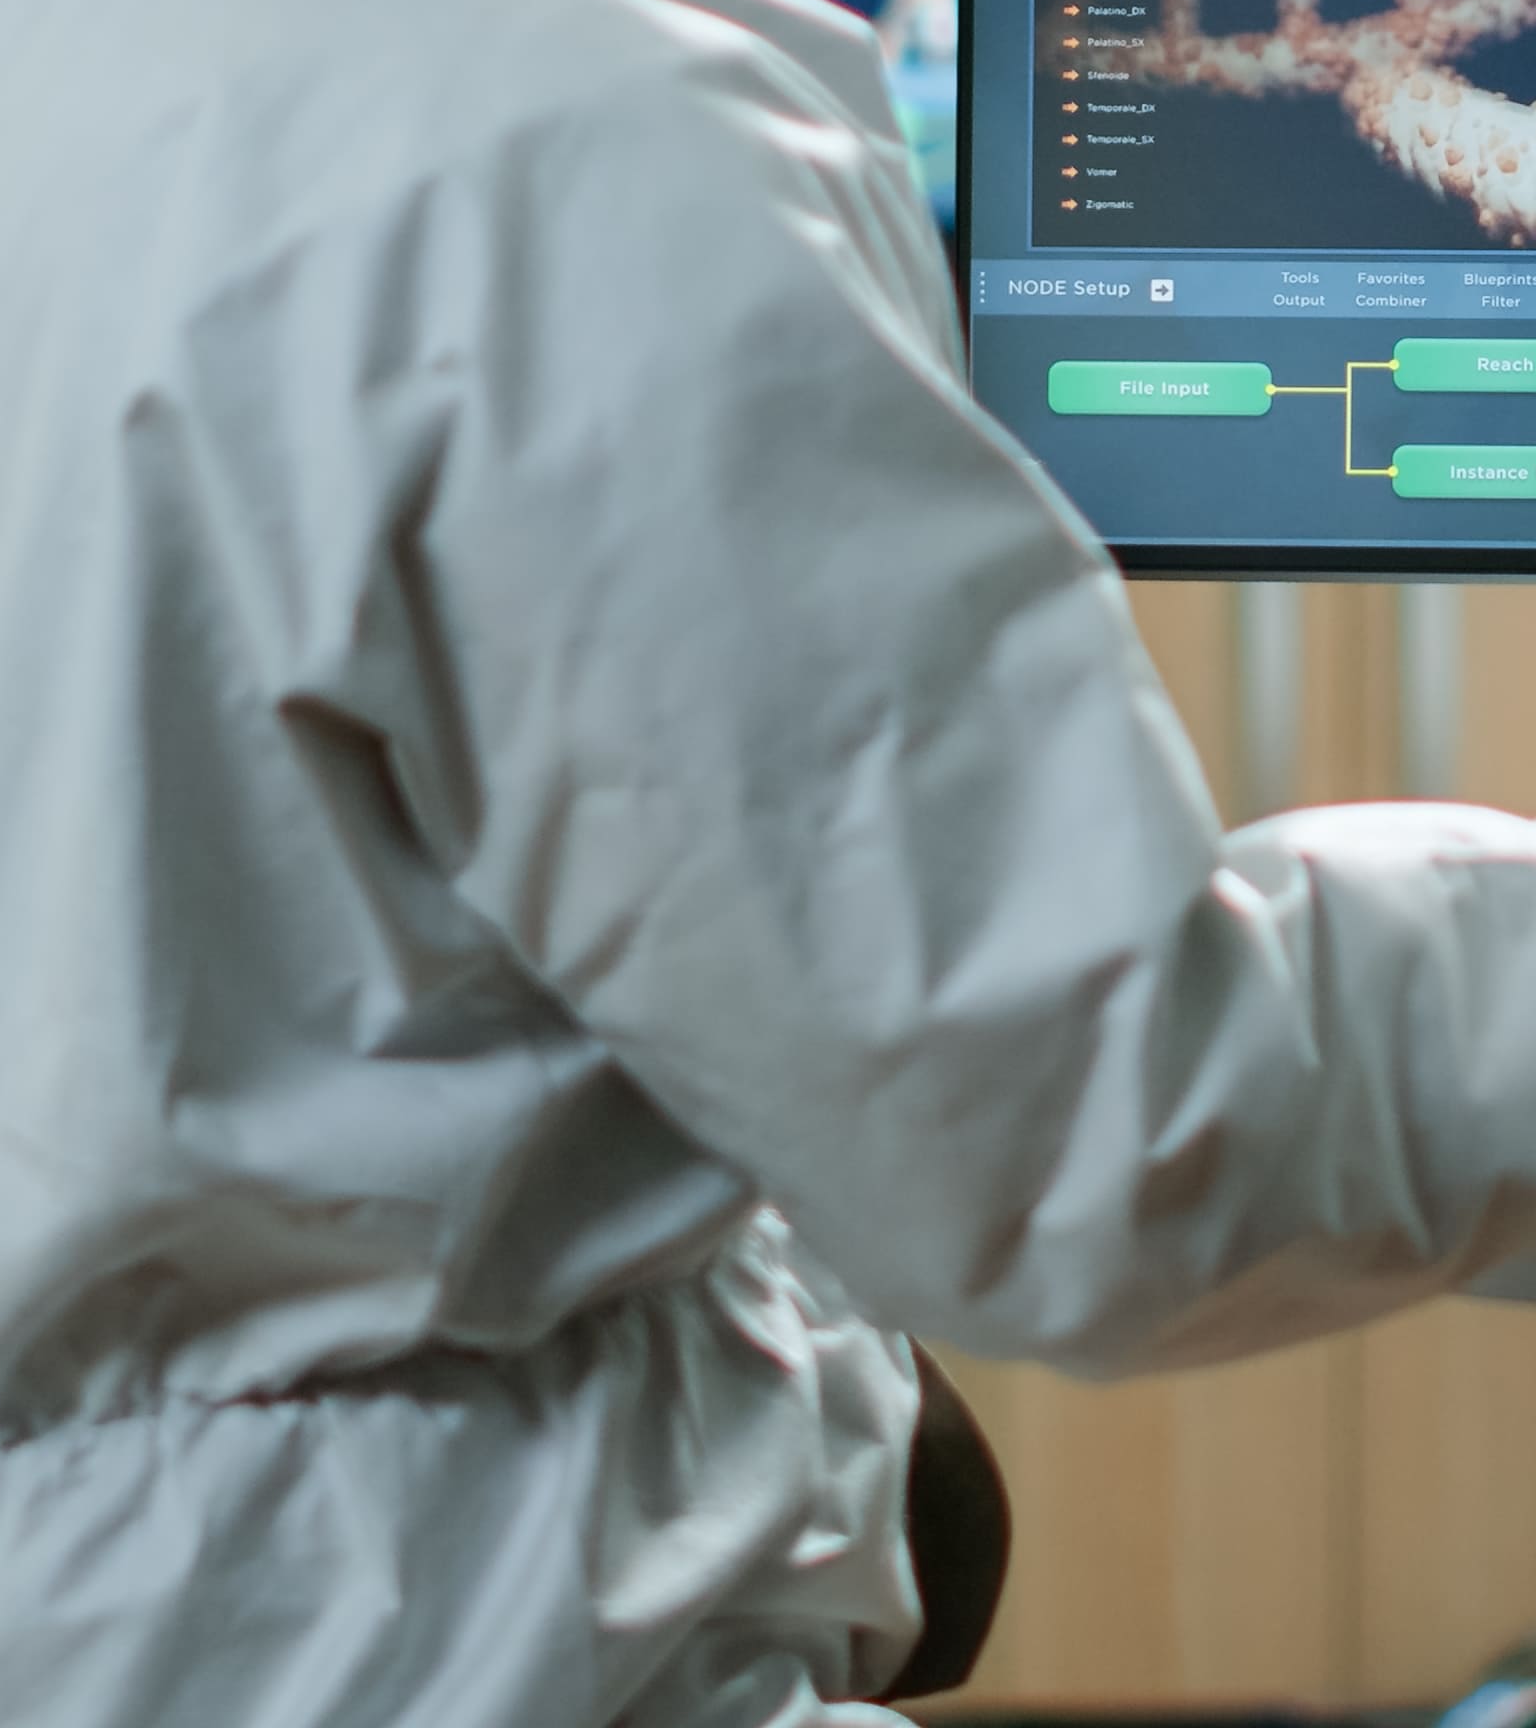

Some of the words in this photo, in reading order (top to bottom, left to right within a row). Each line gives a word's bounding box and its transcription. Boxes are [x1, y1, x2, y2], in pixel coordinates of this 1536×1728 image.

[1087, 6, 1146, 17] Palatino_DX
[1087, 37, 1145, 49] Palatino_SX
[1087, 71, 1130, 81] Sfenoide
[1087, 102, 1156, 114] Temporale_DX
[1086, 134, 1155, 145] Temporale_SX
[1086, 167, 1118, 177] Vomer
[1085, 199, 1134, 211] Zigomatic
[1281, 271, 1320, 284] Tools
[1357, 272, 1425, 285] Favorites
[1008, 279, 1067, 296] NODE
[1073, 280, 1131, 298] Setup
[1273, 294, 1325, 308] Output
[1355, 294, 1427, 307] Combiner
[1481, 295, 1521, 308] Filter
[1477, 357, 1534, 372] Reach
[1119, 380, 1155, 395] File
[1161, 382, 1209, 398] Input
[1450, 465, 1529, 480] Instance
